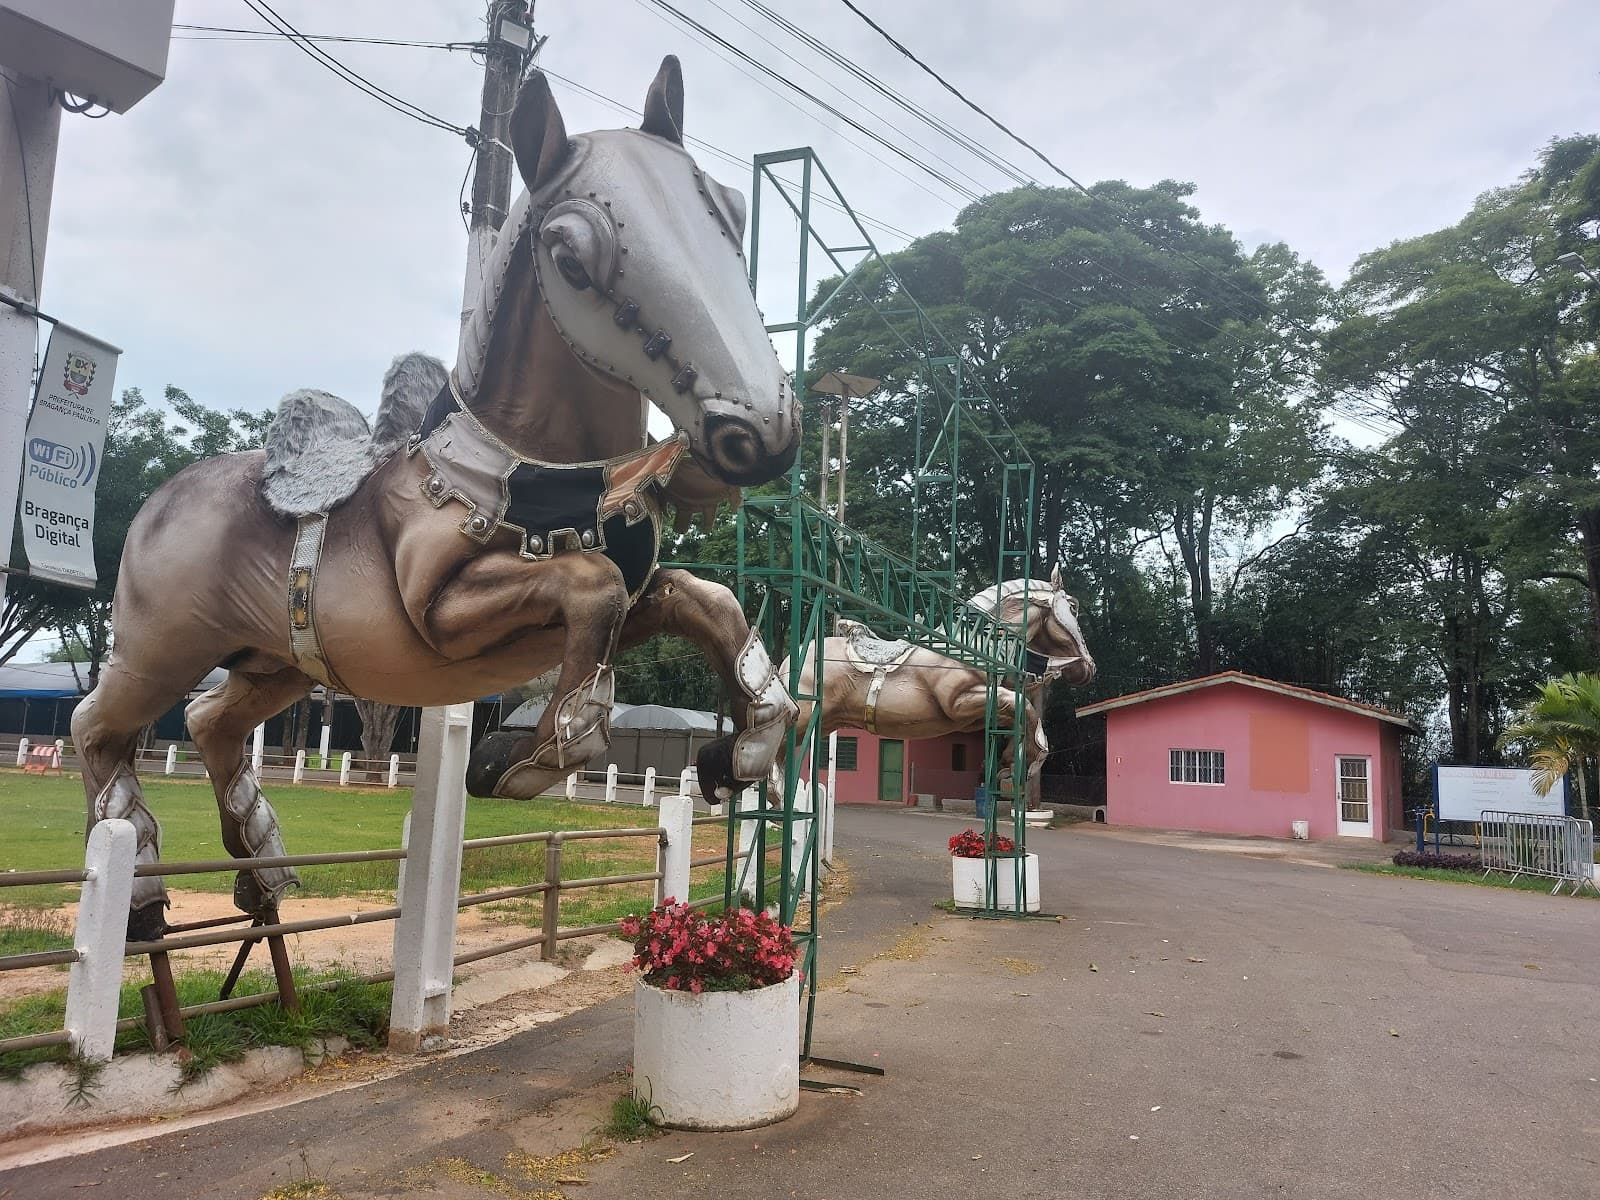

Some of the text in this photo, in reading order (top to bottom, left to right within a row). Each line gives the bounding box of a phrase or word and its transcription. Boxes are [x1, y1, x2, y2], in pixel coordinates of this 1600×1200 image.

[40, 400, 100, 425] BRAGANÇA PAULISTA
[49, 394, 95, 416] PREFEITURA DE
[29, 464, 78, 489] Público
[25, 500, 89, 531] Bragança
[35, 524, 80, 548] Digital
